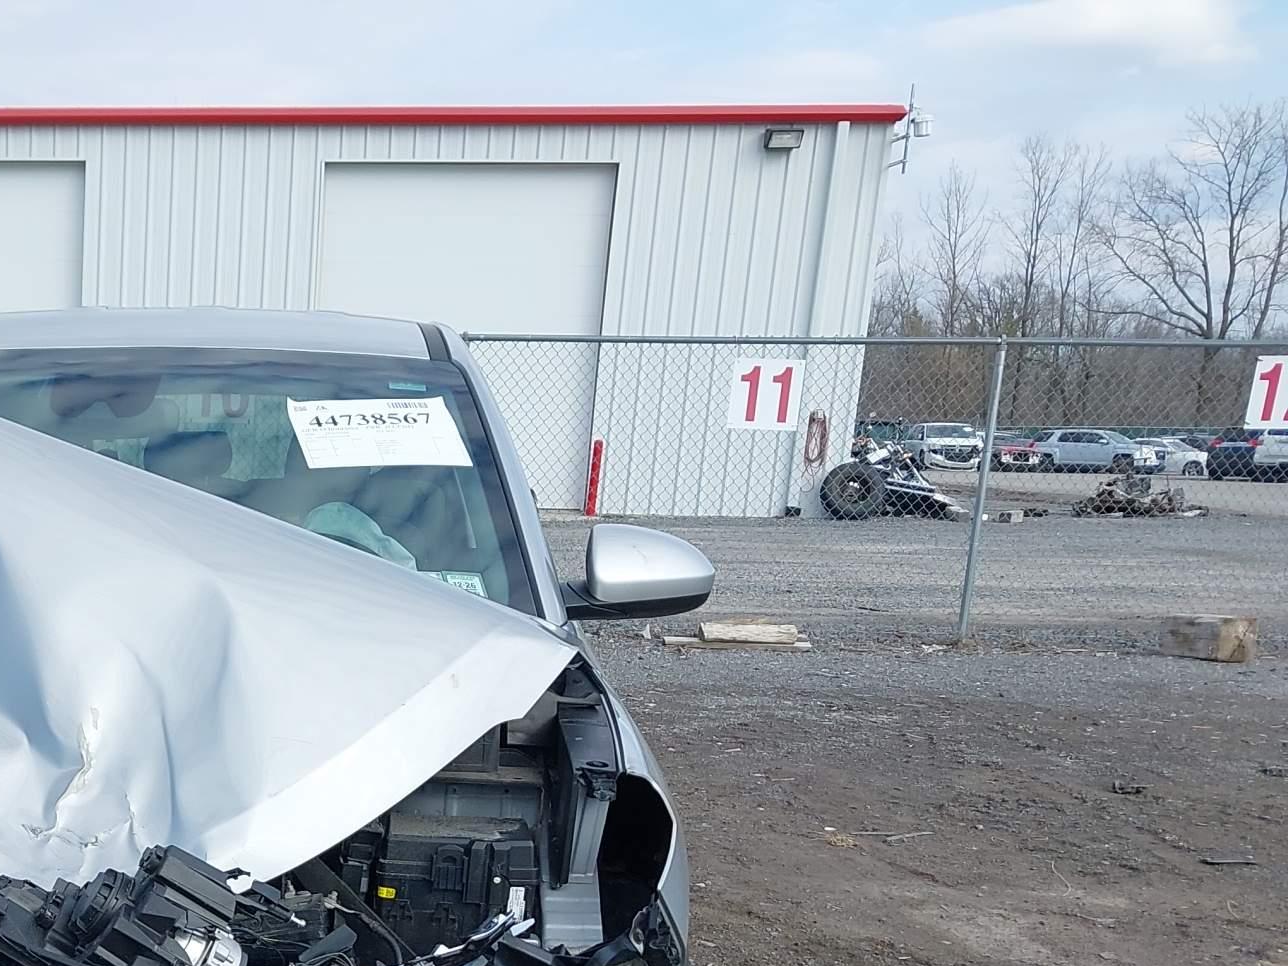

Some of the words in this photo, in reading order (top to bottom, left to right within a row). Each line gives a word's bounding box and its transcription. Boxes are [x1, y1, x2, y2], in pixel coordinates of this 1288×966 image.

[309, 412, 430, 428] 44738567
[741, 366, 793, 423] 11
[1259, 363, 1288, 421] 1
